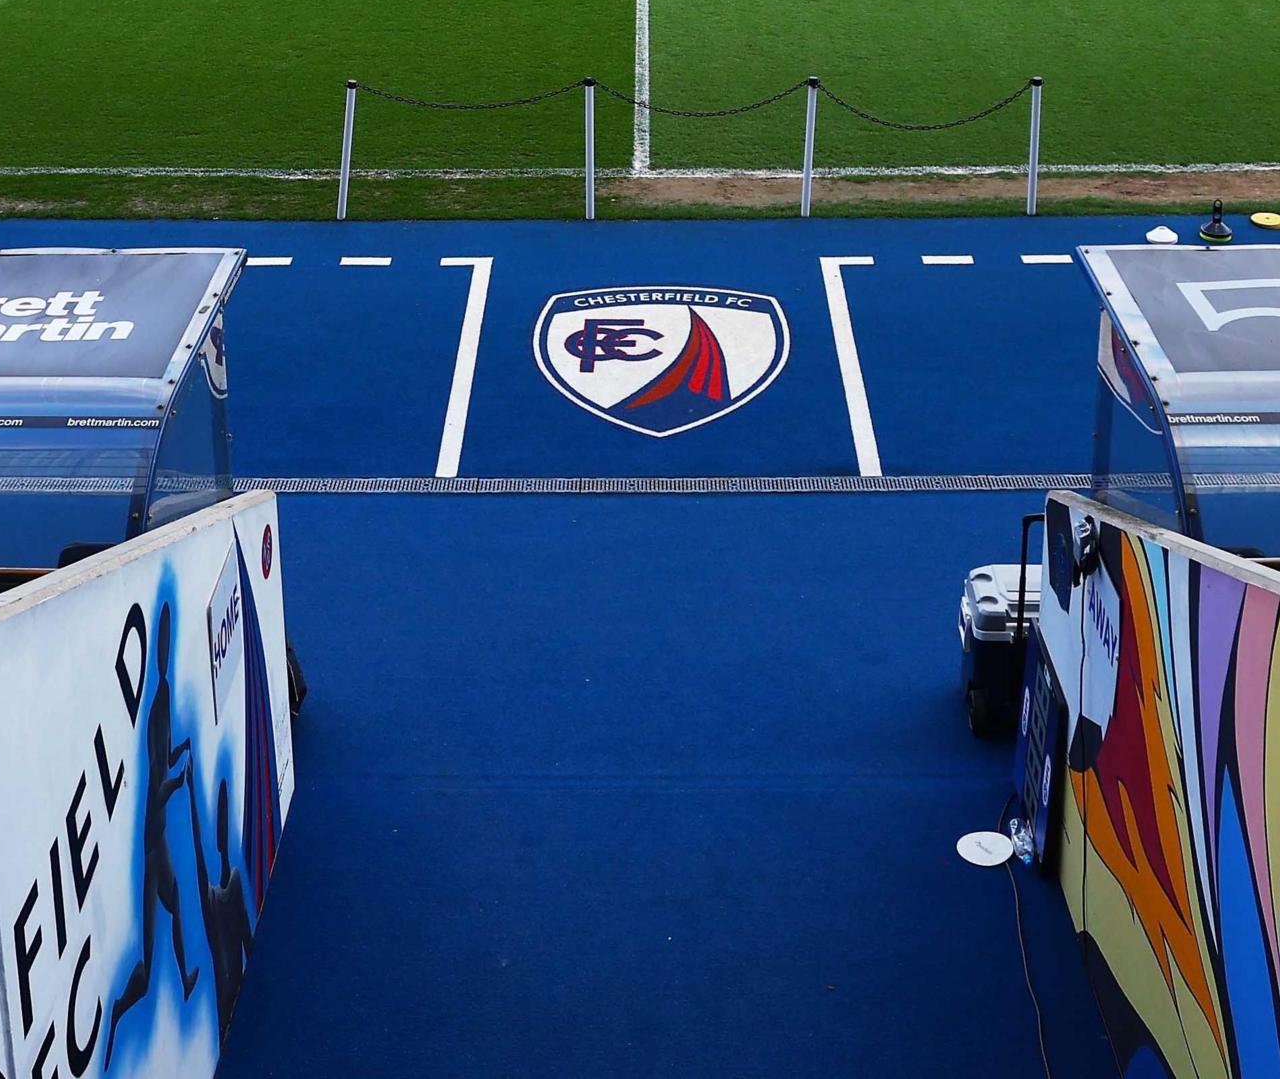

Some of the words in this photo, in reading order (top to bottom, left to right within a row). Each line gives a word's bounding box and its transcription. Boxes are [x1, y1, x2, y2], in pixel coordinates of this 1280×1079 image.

[574, 292, 719, 308] CHESTERFIELD
[725, 296, 752, 308] FC
[66, 418, 159, 427] brettmartin.com
[1167, 414, 1260, 423] brettmartin.com
[213, 583, 240, 679] HOME
[1088, 582, 1118, 667] AWAY
